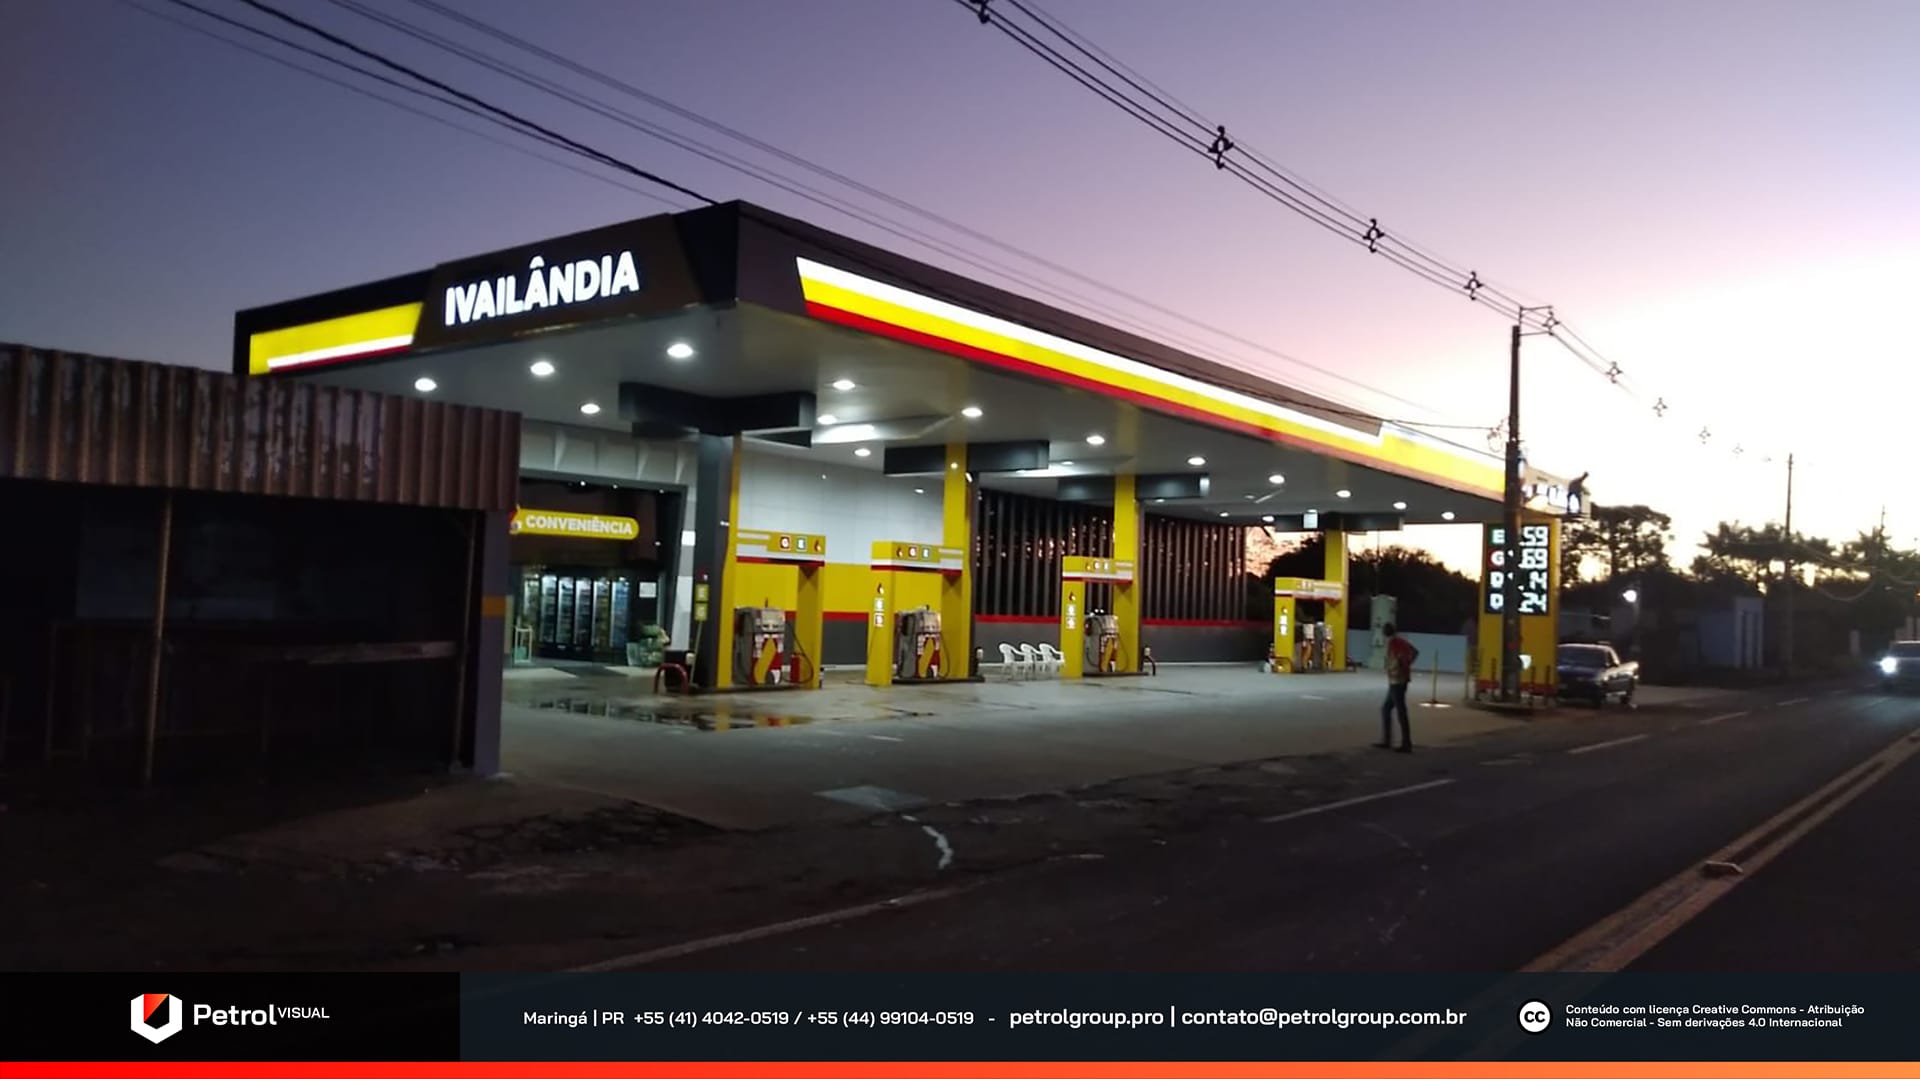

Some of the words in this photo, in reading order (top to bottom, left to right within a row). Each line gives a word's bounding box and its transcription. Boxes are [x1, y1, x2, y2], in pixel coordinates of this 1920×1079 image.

[445, 251, 640, 326] IVAILÂNDIA
[525, 514, 633, 535] CONVENIÊNCIA
[1492, 529, 1505, 544] E
[1518, 526, 1548, 546] .59
[1490, 550, 1505, 566] G
